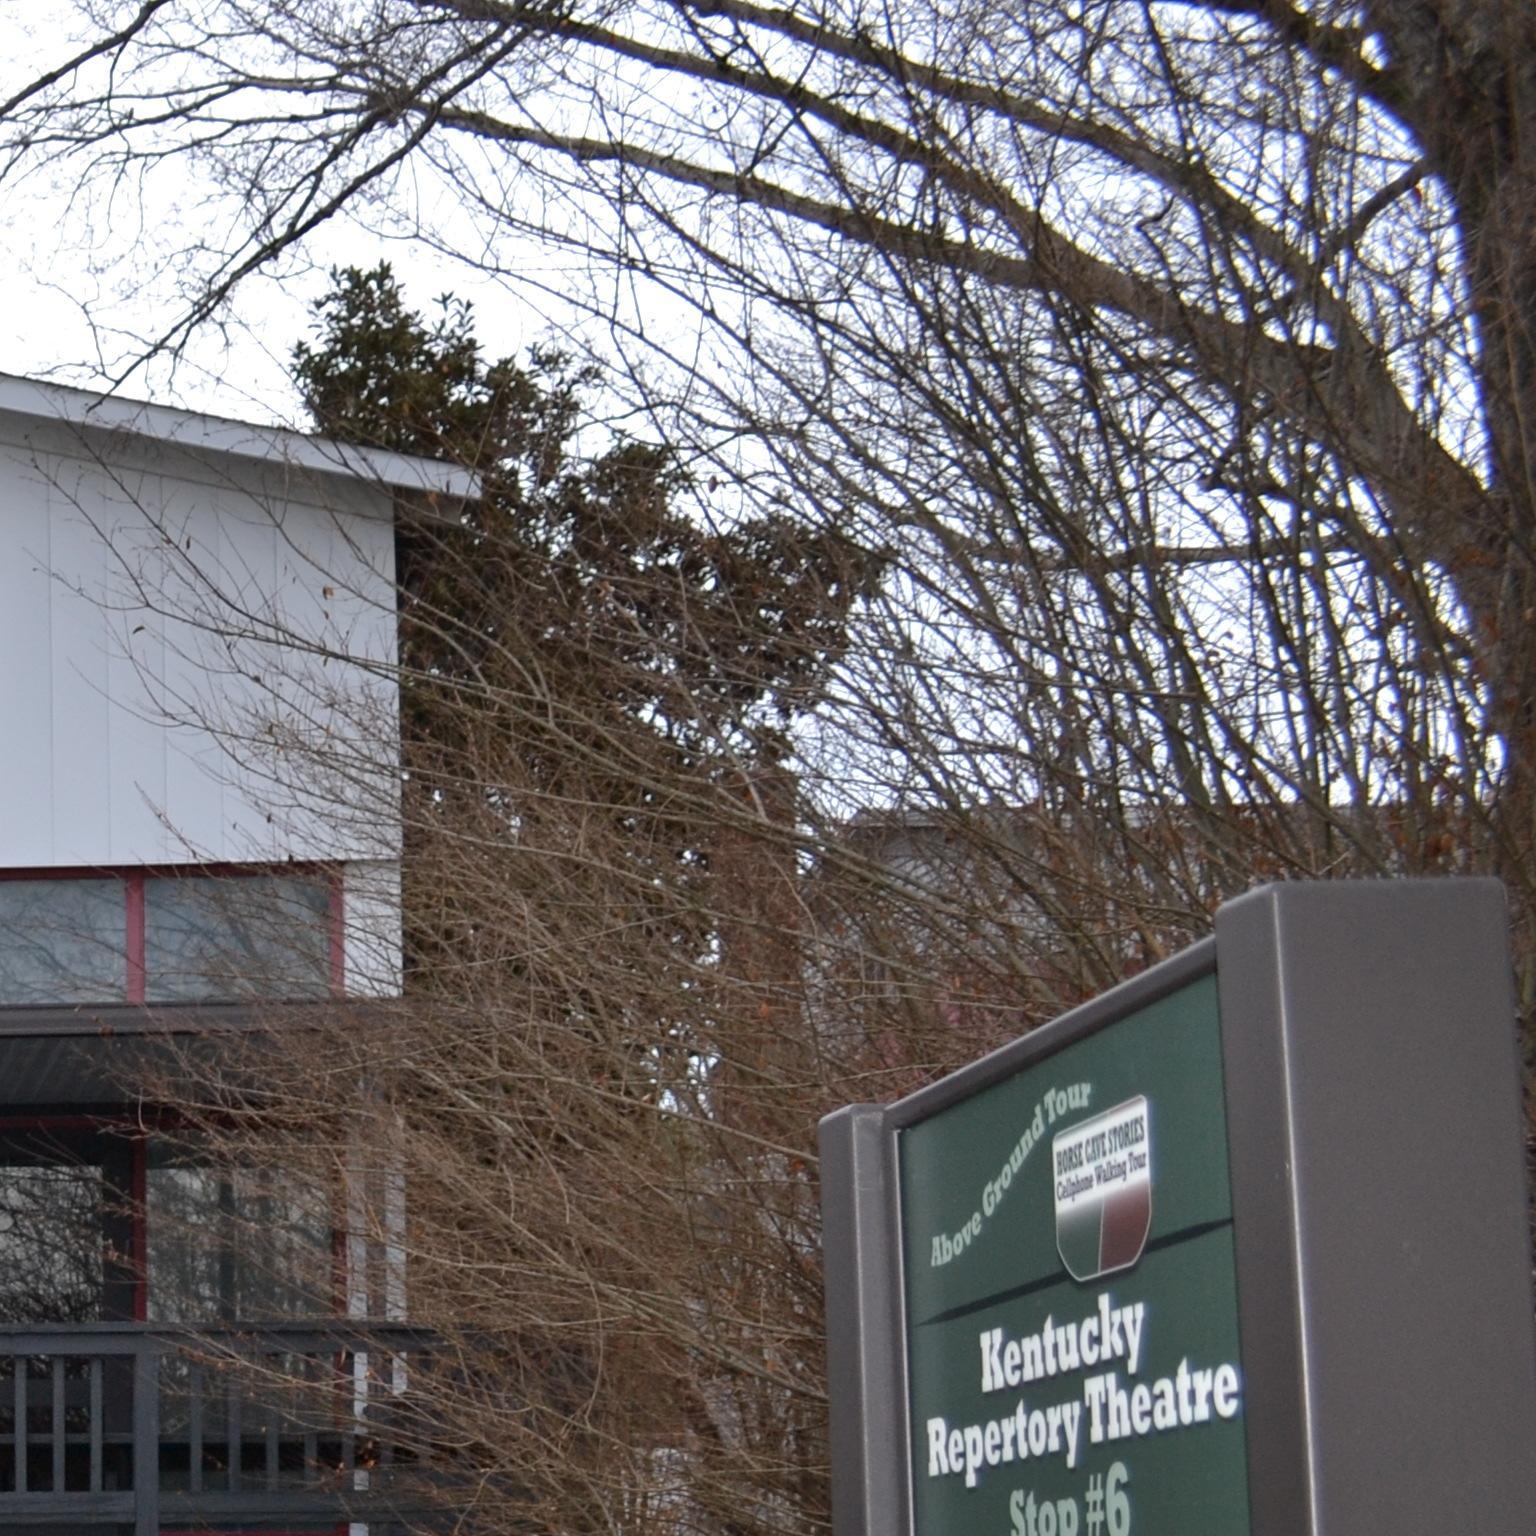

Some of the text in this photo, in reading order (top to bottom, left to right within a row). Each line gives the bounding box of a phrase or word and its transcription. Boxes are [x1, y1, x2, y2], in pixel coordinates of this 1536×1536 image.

[931, 1082, 1091, 1267] Above Ground Tour
[1056, 1115, 1145, 1177] HORSE CAVE STORIES
[1056, 1151, 1147, 1202] Cellphone Walking Tour
[979, 1292, 1144, 1393] Kentucky
[927, 1355, 1239, 1488] Repertory Theatre
